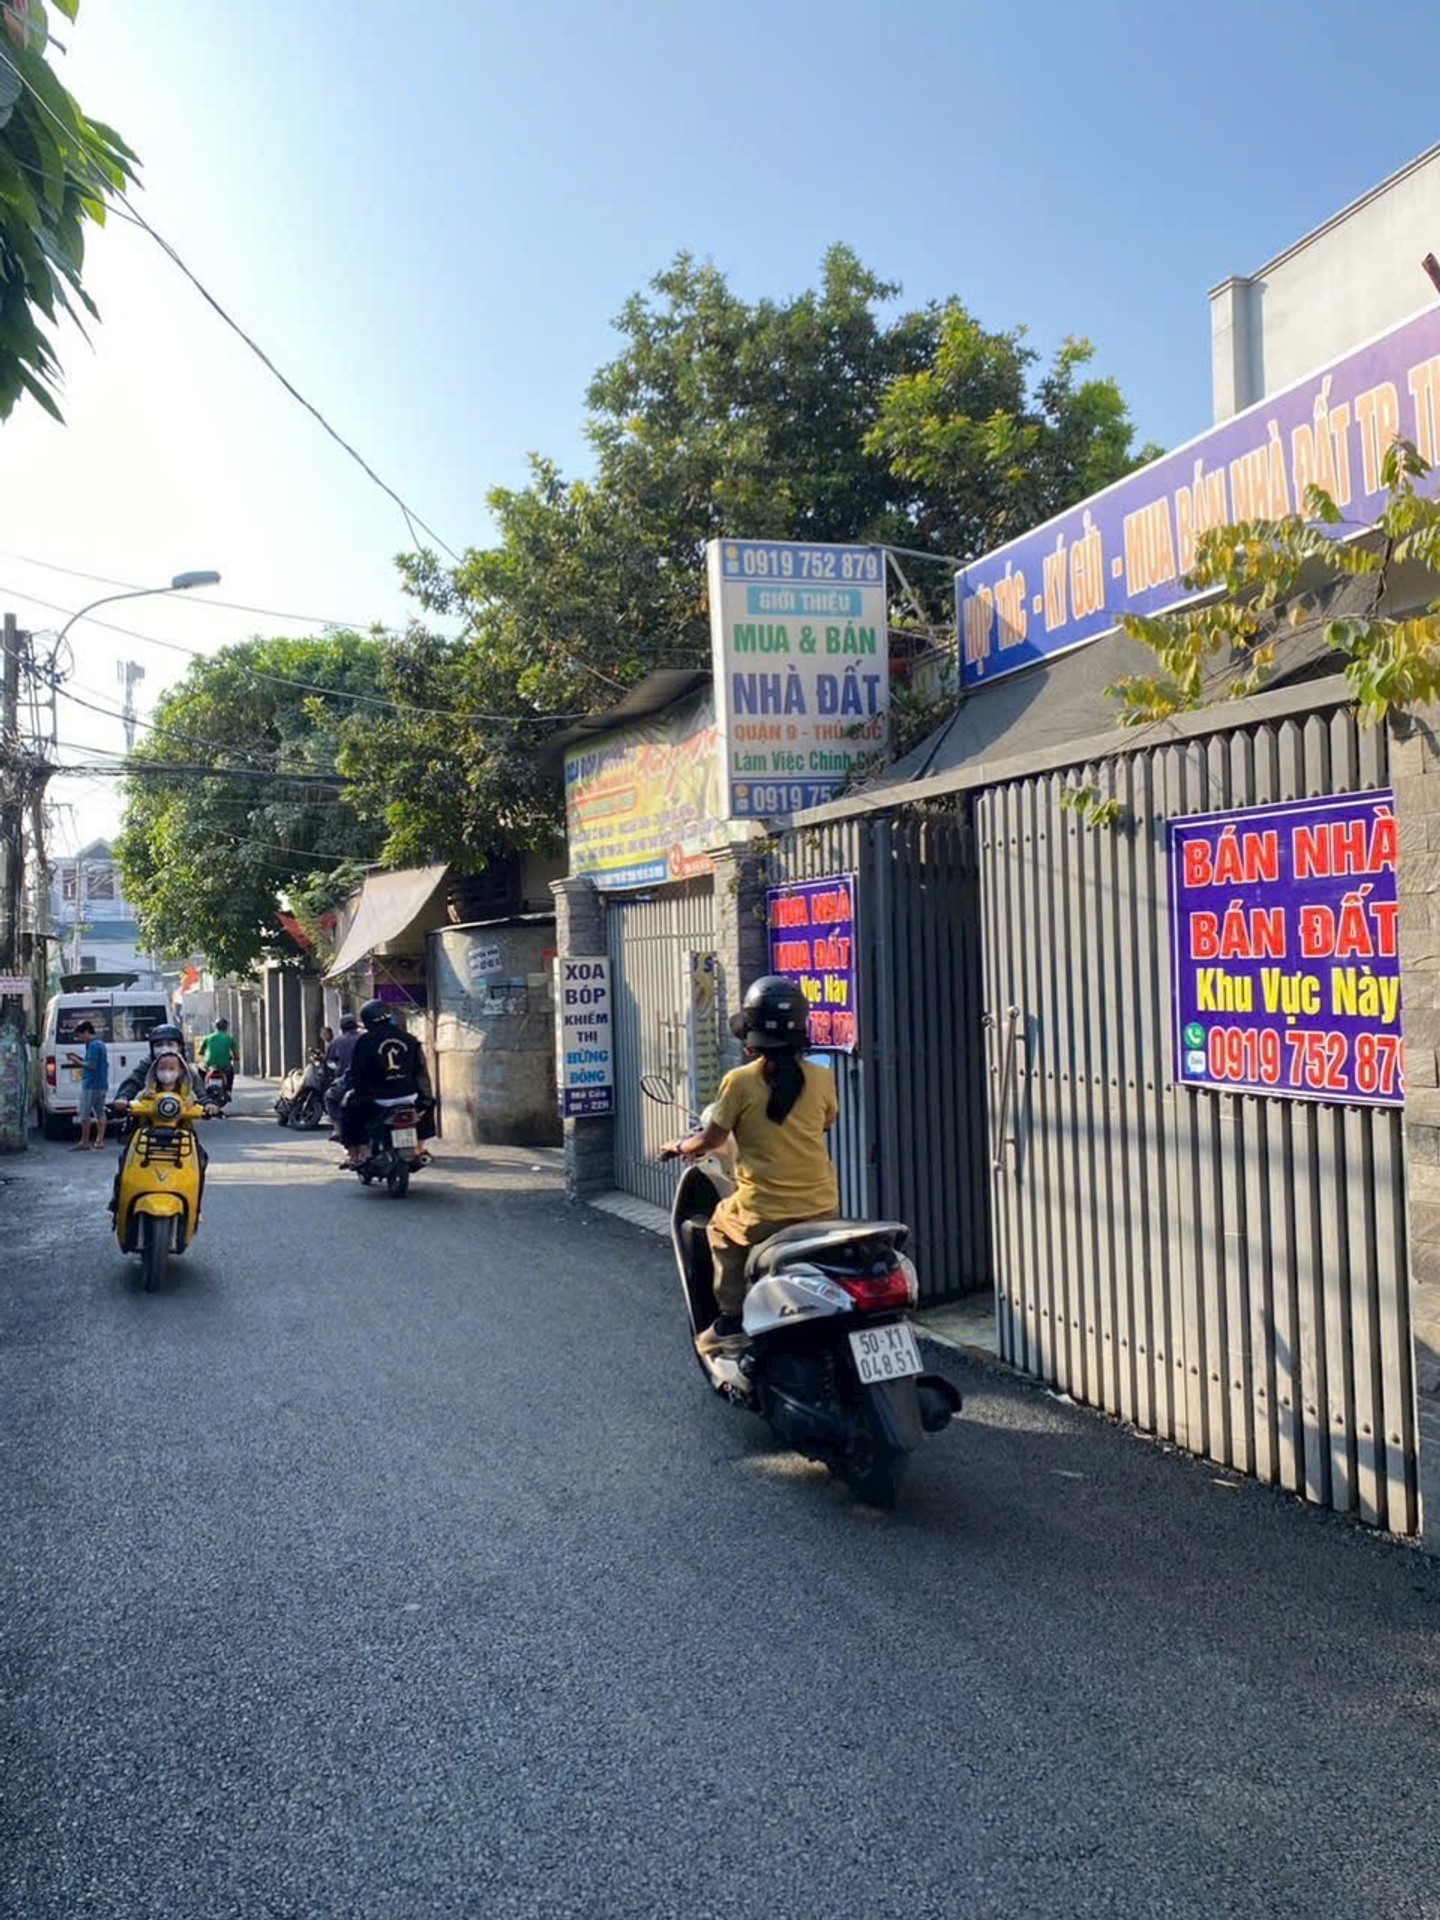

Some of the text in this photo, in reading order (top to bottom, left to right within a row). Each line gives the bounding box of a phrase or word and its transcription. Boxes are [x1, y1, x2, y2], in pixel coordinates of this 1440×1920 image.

[994, 559, 1027, 652] TÁC
[1042, 532, 1068, 633] KÝ
[1123, 496, 1176, 598] MUA
[1354, 381, 1400, 496] TP
[743, 549, 793, 577] 0919
[801, 553, 836, 579] 752
[841, 554, 877, 580] 879
[733, 621, 876, 655] MUA & BÁN
[732, 660, 880, 715] NHÀ ĐẤT
[735, 722, 782, 745] QUẬN
[734, 750, 767, 772] Làm
[772, 750, 804, 775] Việc
[809, 749, 851, 771] Chính
[752, 785, 803, 812] 0919
[1183, 806, 1398, 888] BÁN NHÀ
[1190, 884, 1399, 959] BÁN ĐẤT
[774, 927, 851, 971] MUA ĐẤT
[565, 964, 605, 981] XOA
[565, 985, 606, 1005] BÓP
[1196, 966, 1399, 1024] Khu Vực Này
[565, 1012, 608, 1026] KHIẾM
[577, 1031, 598, 1044] THỊ
[1208, 1026, 1281, 1084] 0919
[1286, 1030, 1349, 1091] 752
[859, 1327, 904, 1356] 50-X1
[860, 1349, 917, 1380] 048.51
